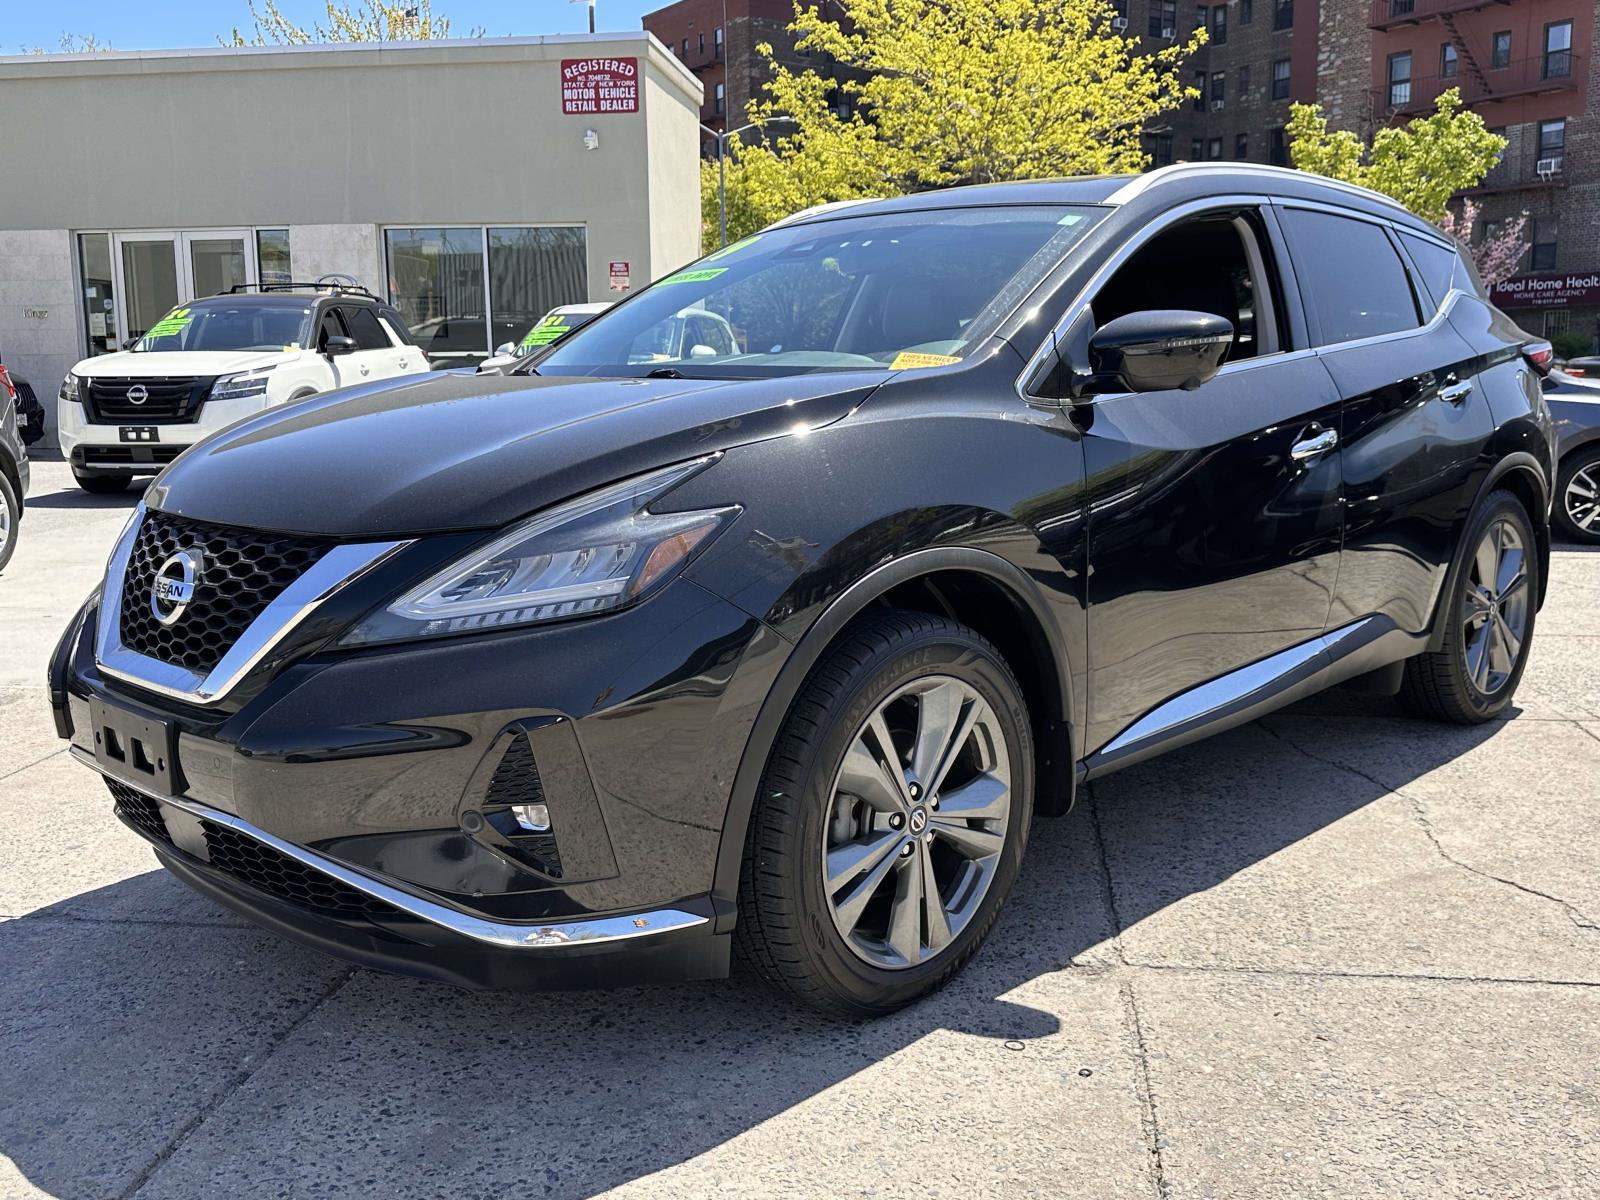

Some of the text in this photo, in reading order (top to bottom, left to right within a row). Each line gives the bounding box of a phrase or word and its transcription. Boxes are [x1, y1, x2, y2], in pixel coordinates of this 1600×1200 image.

[564, 59, 635, 79] REGISTERED
[564, 87, 636, 100] MOTOR VEHICLE
[565, 99, 635, 112] RETAIL DEALER
[1496, 275, 1600, 292] Ideal Home Healt
[1537, 290, 1555, 298] CARE
[1556, 289, 1587, 297] AGENCY
